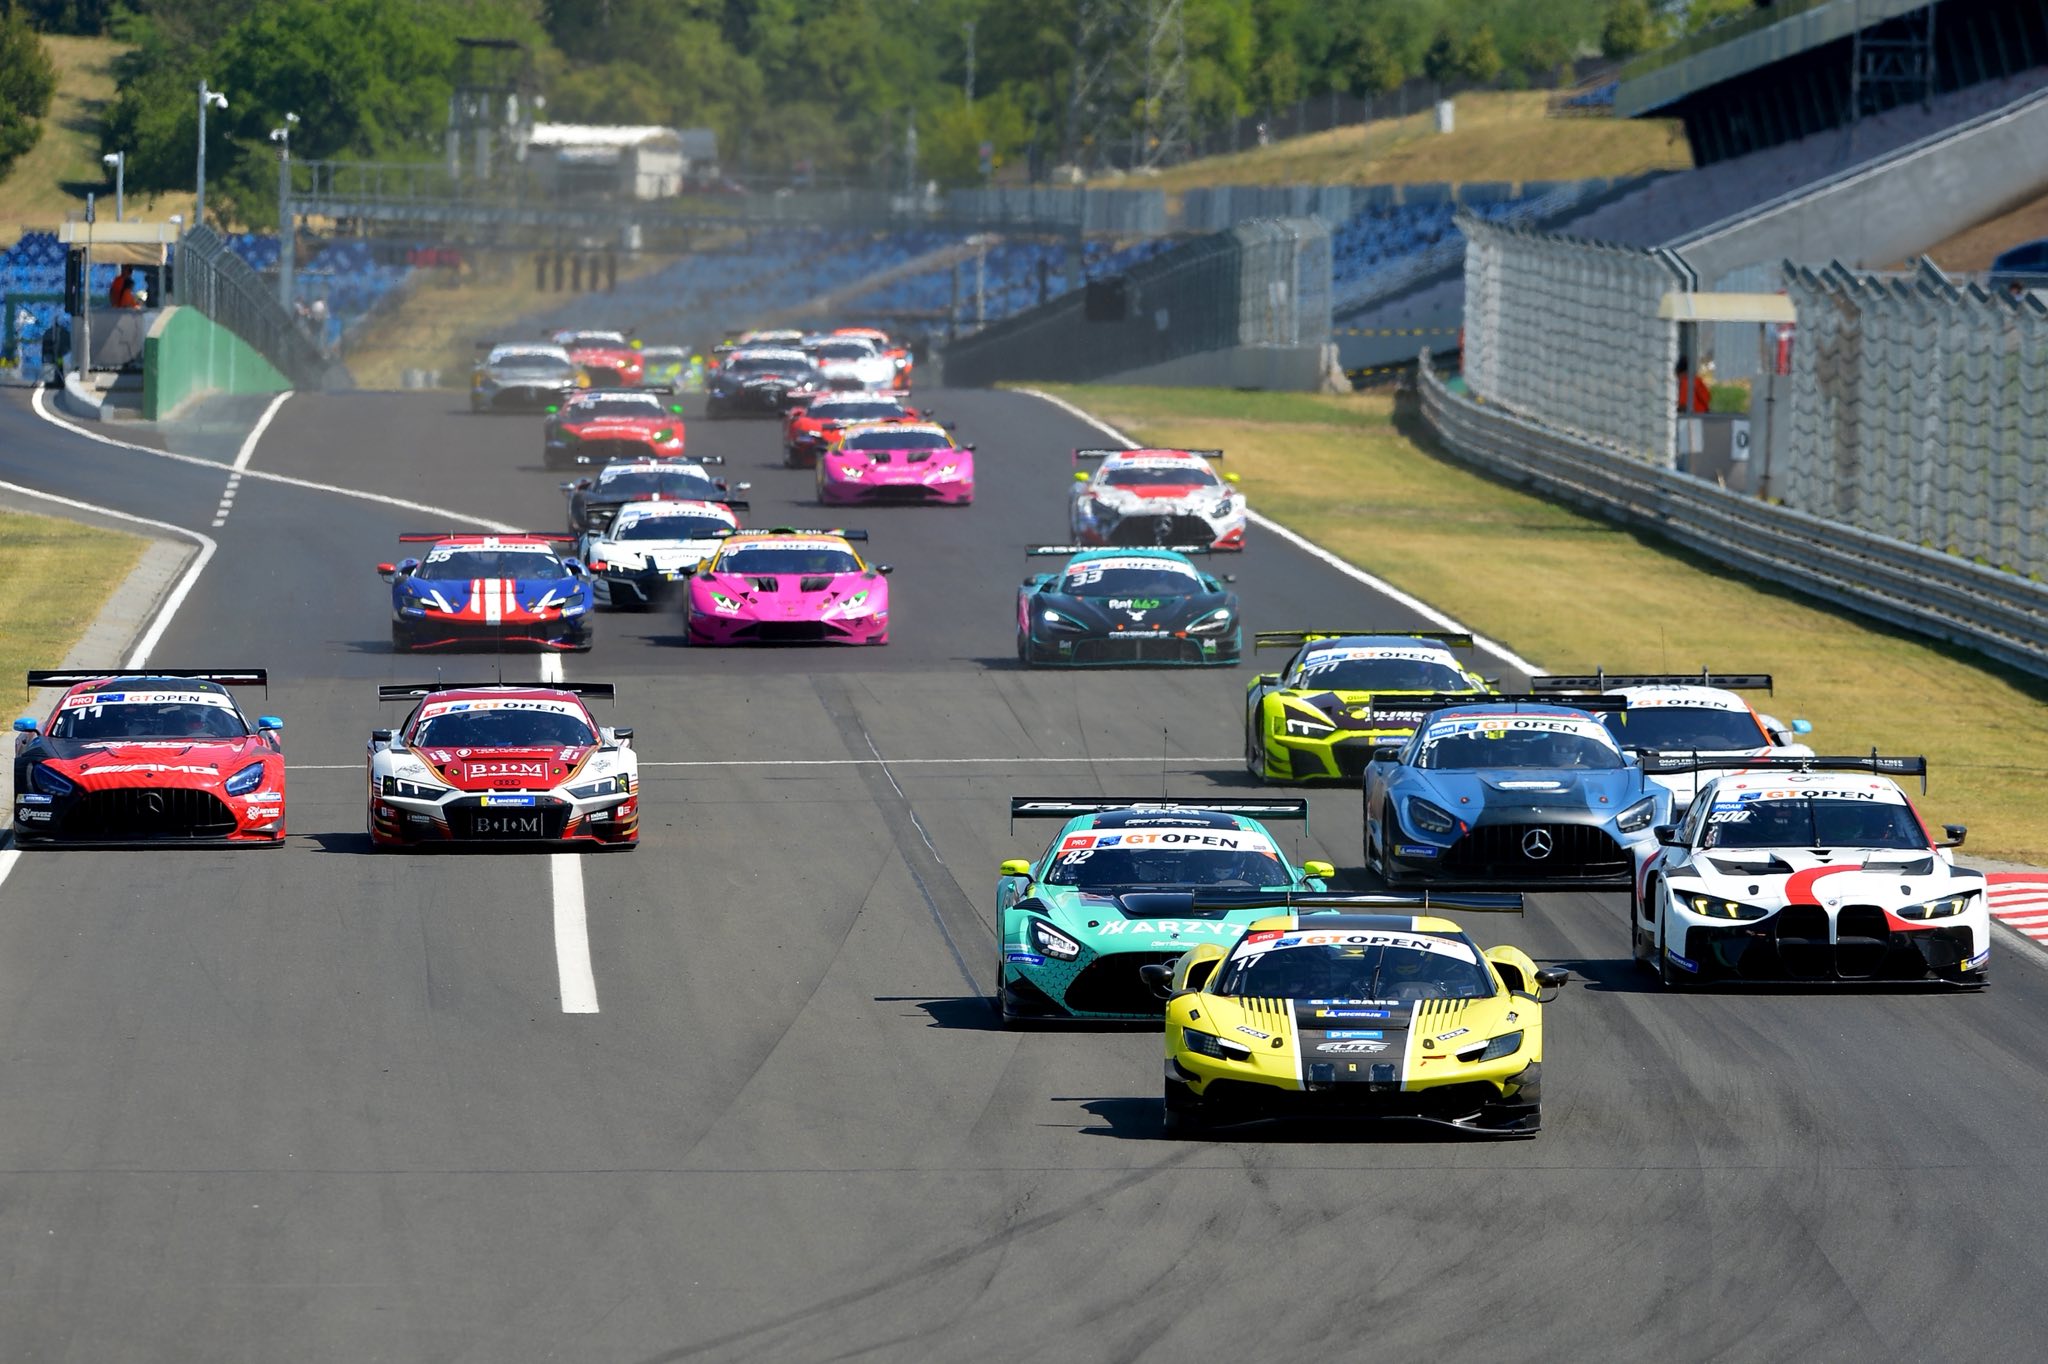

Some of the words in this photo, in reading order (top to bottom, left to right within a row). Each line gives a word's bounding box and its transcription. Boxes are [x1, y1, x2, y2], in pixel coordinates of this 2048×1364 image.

[1070, 570, 1104, 587] 33
[71, 695, 92, 706] PRO
[72, 705, 103, 720] 11
[421, 719, 433, 732] 1
[1431, 725, 1454, 736] PROAM
[1707, 810, 1751, 824] 500
[1070, 837, 1088, 847] PRO
[1062, 850, 1095, 866] 82
[1257, 933, 1275, 941] PRO
[1236, 952, 1265, 972] 17
